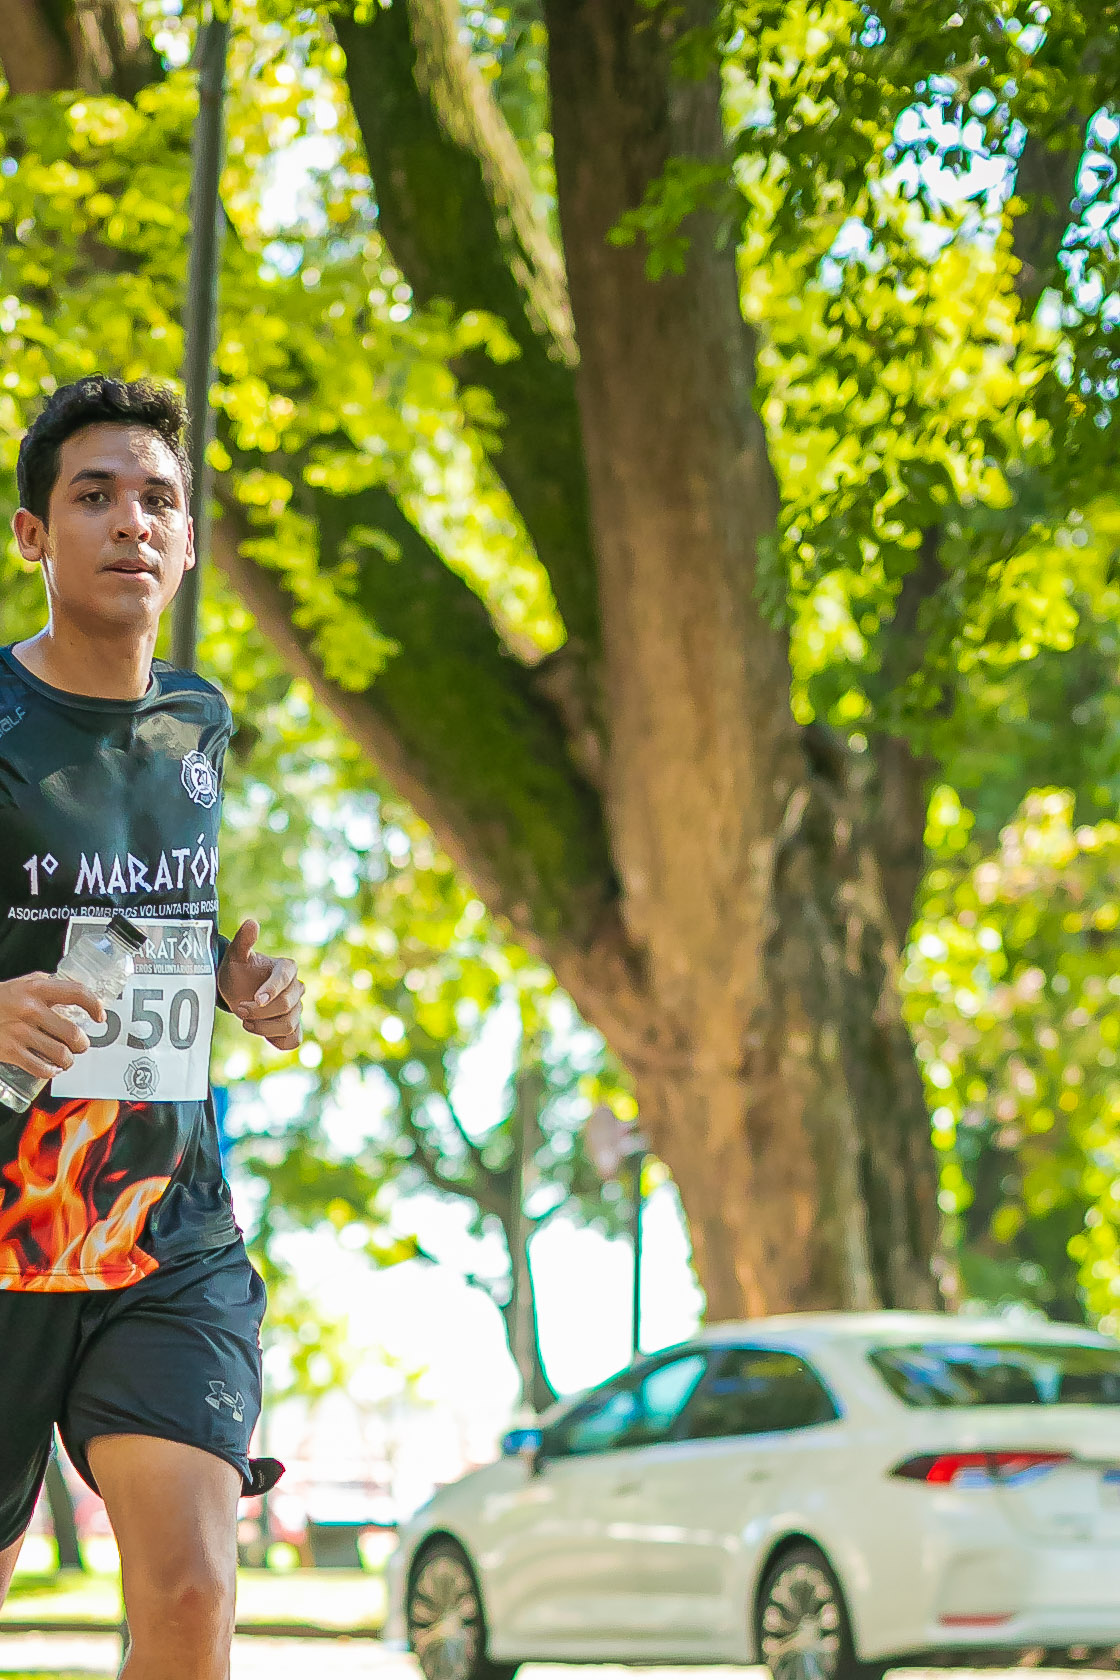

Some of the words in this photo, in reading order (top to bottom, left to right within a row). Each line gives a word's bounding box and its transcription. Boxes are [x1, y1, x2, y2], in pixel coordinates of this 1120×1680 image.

[73, 832, 219, 895] MARATÓN
[7, 904, 79, 921] ASOCIACIÓN
[139, 902, 200, 917] VOLUNTARIOS
[135, 1068, 151, 1086] 27
